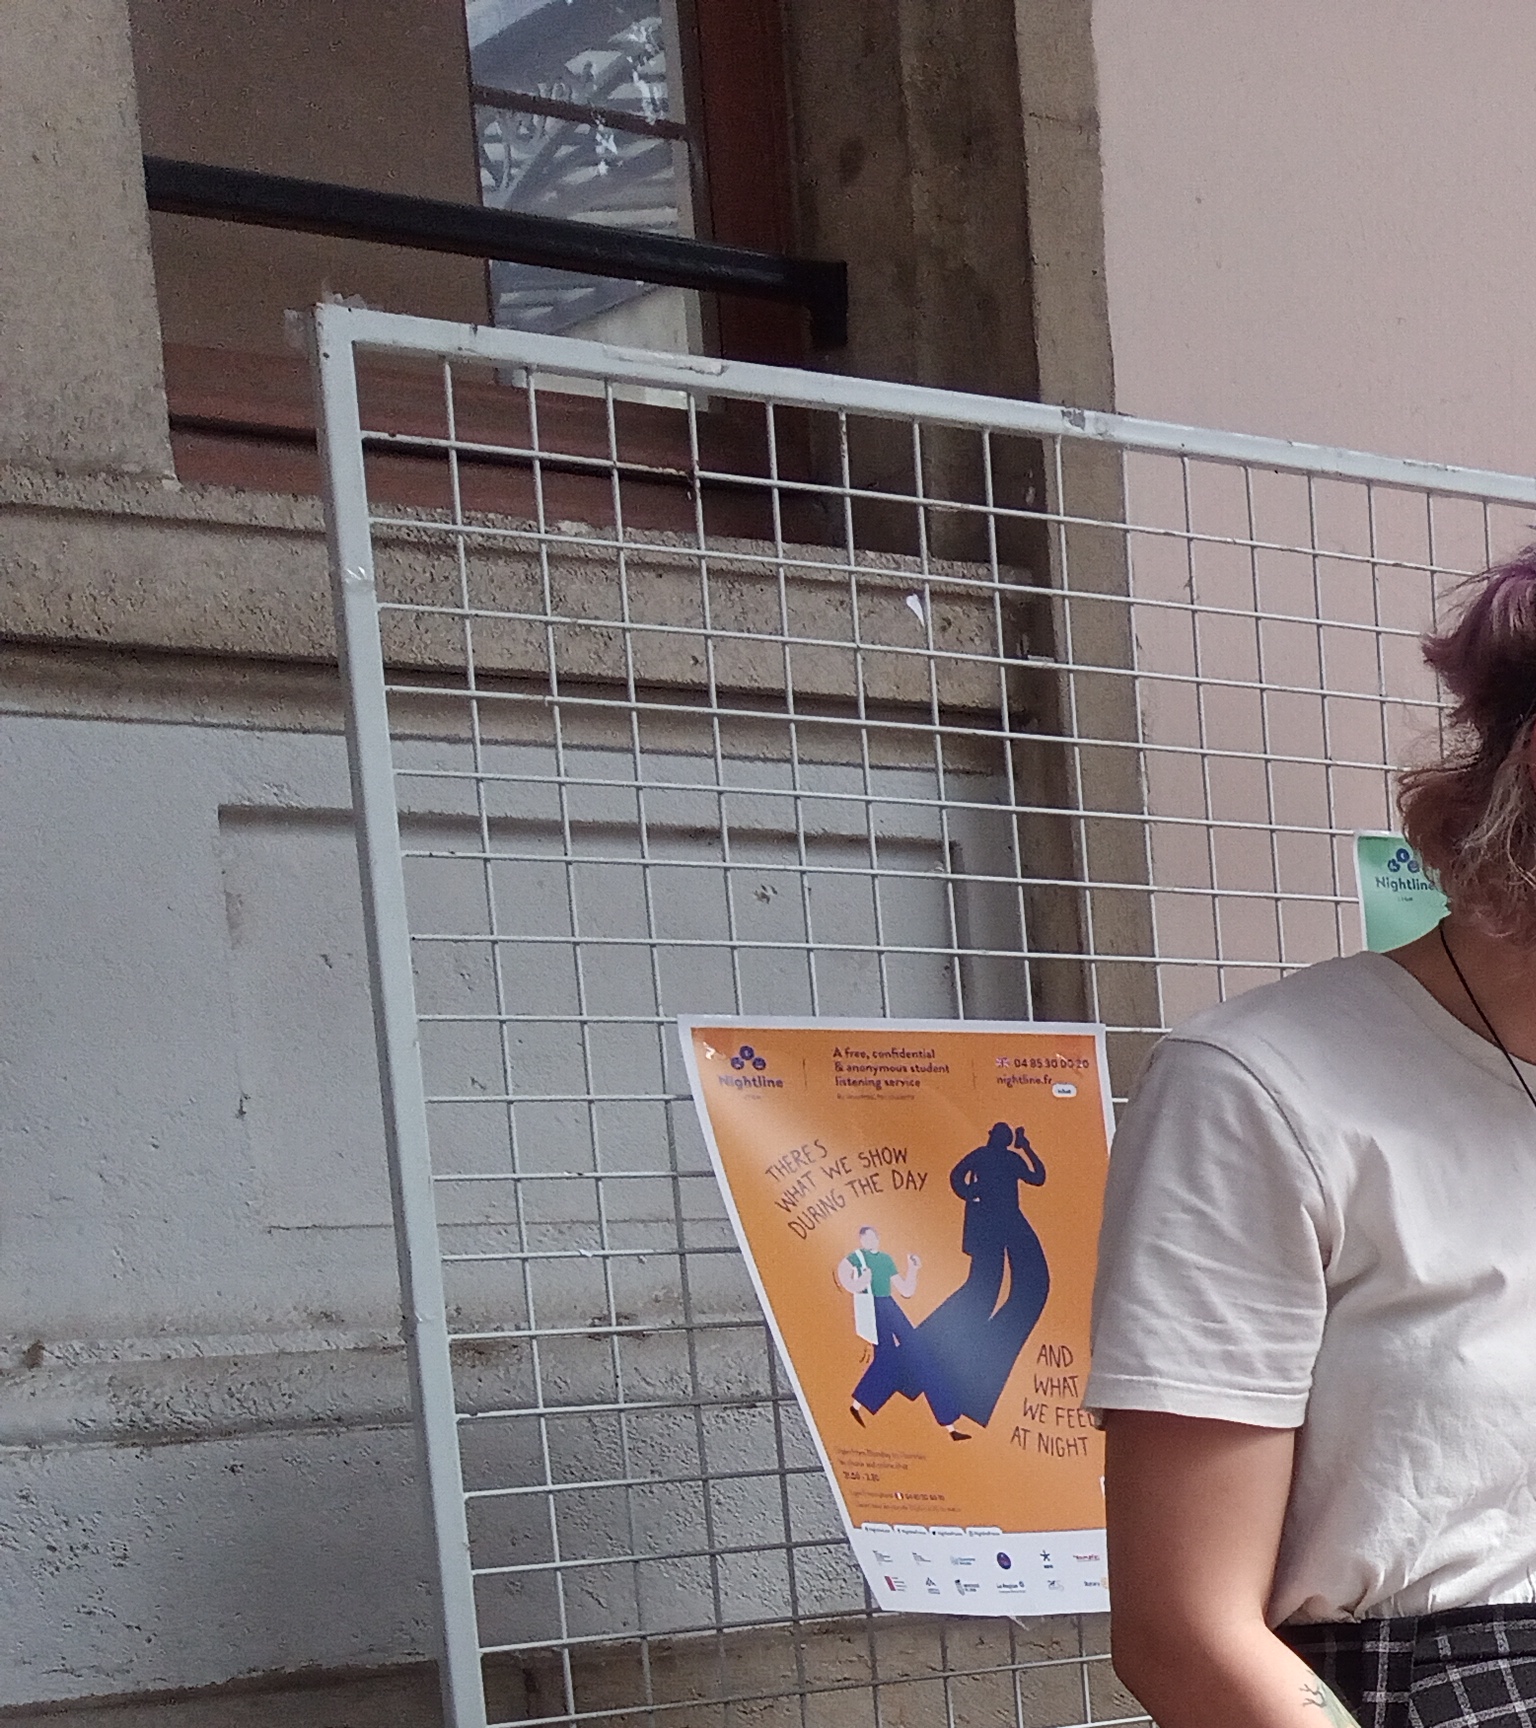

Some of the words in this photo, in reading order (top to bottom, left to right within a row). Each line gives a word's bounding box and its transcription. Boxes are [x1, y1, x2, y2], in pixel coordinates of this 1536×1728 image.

[832, 1047, 841, 1058] A
[871, 1047, 936, 1059] confidential
[846, 1063, 908, 1076] anonymous
[910, 1062, 950, 1074] student
[717, 1074, 784, 1090] Nightline
[834, 1076, 882, 1090] listening
[884, 1077, 922, 1088] service
[773, 1172, 820, 1216] WHAT
[821, 1155, 852, 1179] WE
[857, 1146, 909, 1168] SHOW
[787, 1188, 847, 1242] DURING
[848, 1173, 884, 1199] THE
[892, 1170, 929, 1194] DAY
[1036, 1344, 1074, 1369] AND
[1033, 1375, 1080, 1399] WHAT
[1022, 1398, 1053, 1423] WE
[1055, 1406, 1098, 1429] FEEL
[1010, 1427, 1033, 1448] AT
[1037, 1434, 1089, 1459] NIGHT
